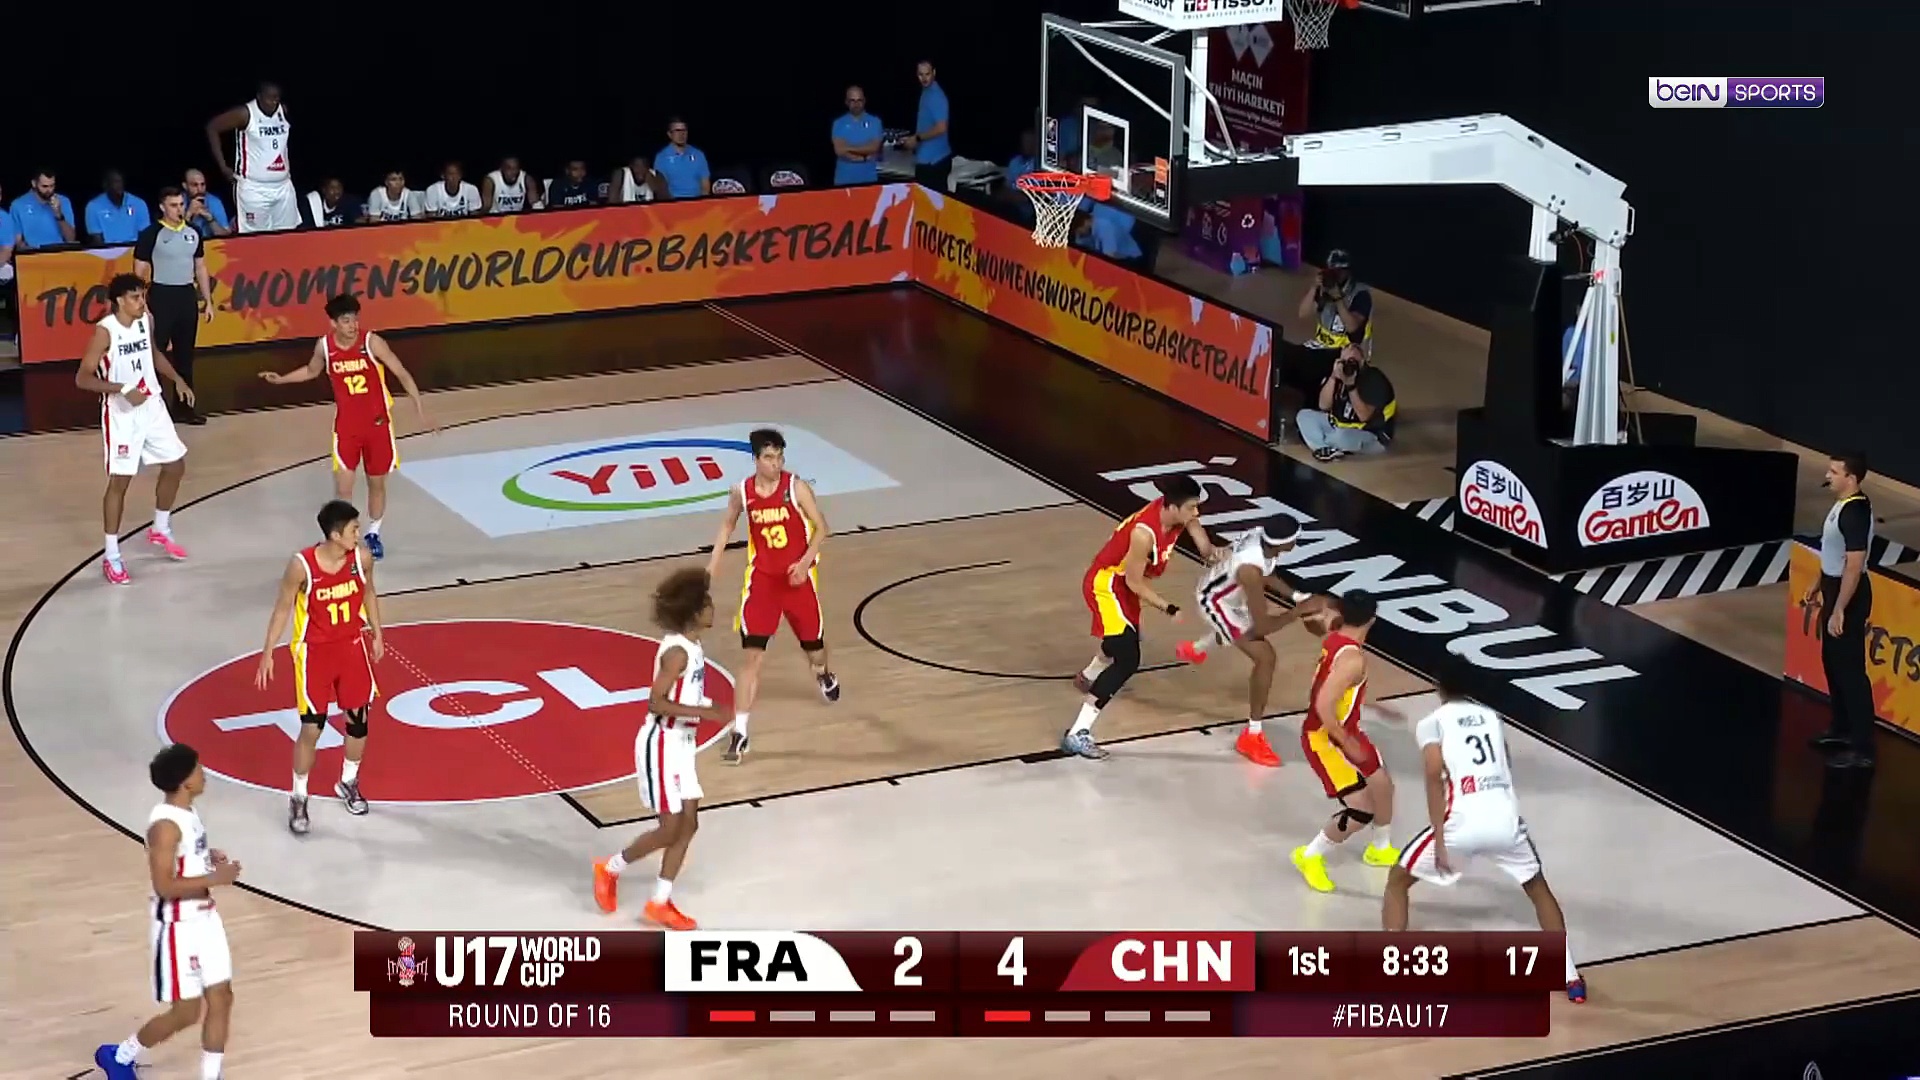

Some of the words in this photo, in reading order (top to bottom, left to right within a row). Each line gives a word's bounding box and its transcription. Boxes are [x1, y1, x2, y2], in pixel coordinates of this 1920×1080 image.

[272, 139, 279, 150] 8
[915, 220, 1259, 396] TICKETS.WOMENSWORLDCUP.BASKETBALL
[118, 339, 149, 356] FRANCE
[131, 358, 142, 372] 14
[332, 358, 368, 374] CHINA
[344, 375, 368, 395] 12
[550, 456, 724, 496] Yili
[1476, 465, 1524, 503] 百岁山
[1602, 479, 1675, 509] 百岁山
[751, 506, 790, 524] CHINA
[761, 526, 788, 549] 13
[316, 579, 359, 601] CHINA
[326, 601, 350, 625] 11
[212, 666, 651, 749] TCL
[1465, 733, 1496, 765] 31
